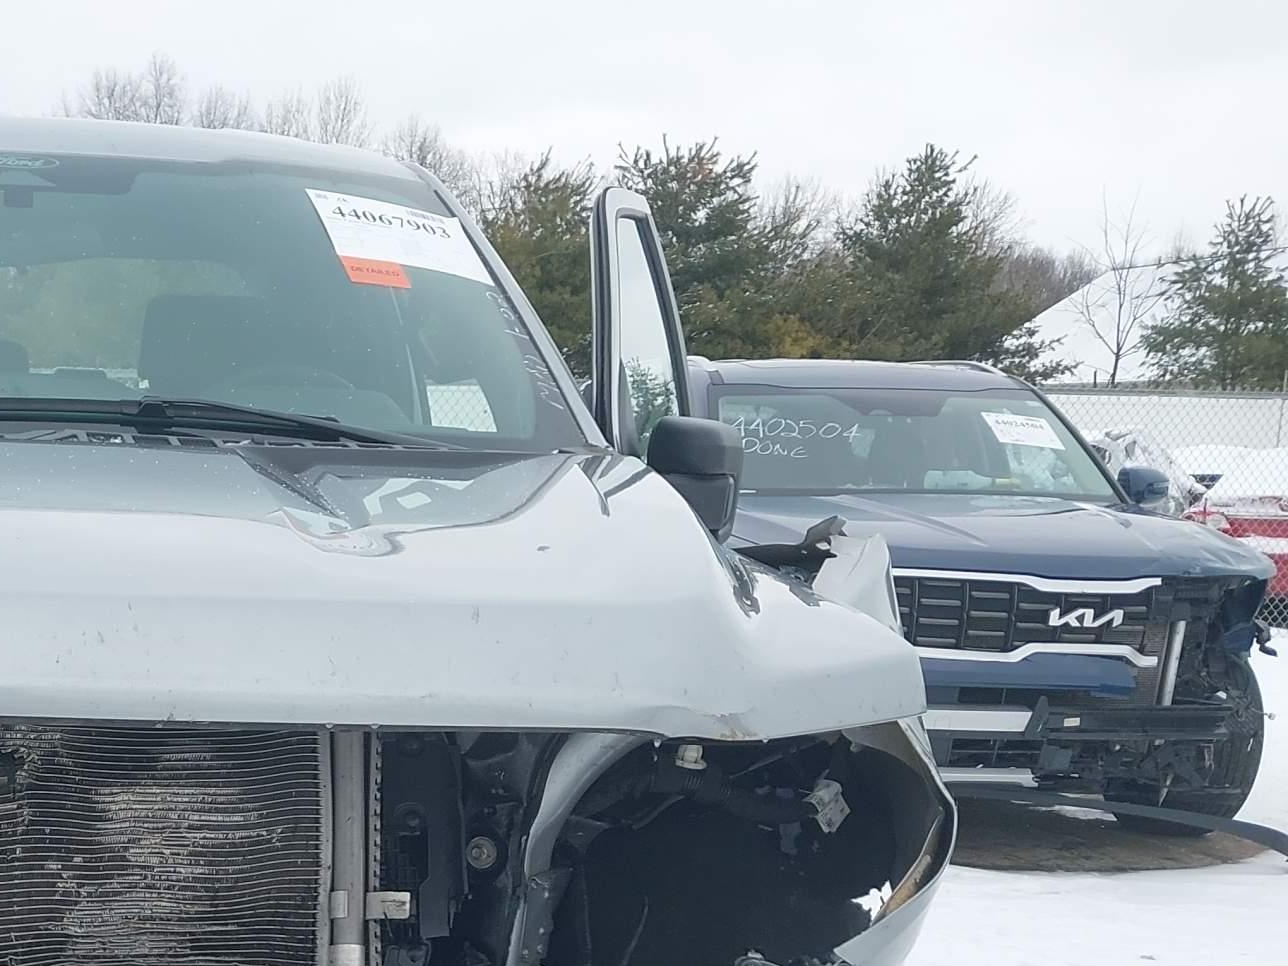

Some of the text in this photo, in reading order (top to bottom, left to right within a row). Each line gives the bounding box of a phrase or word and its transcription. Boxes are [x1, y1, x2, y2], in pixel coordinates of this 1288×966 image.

[332, 206, 451, 239] 44067903
[730, 415, 861, 443] 4402504
[741, 437, 809, 458] DONE
